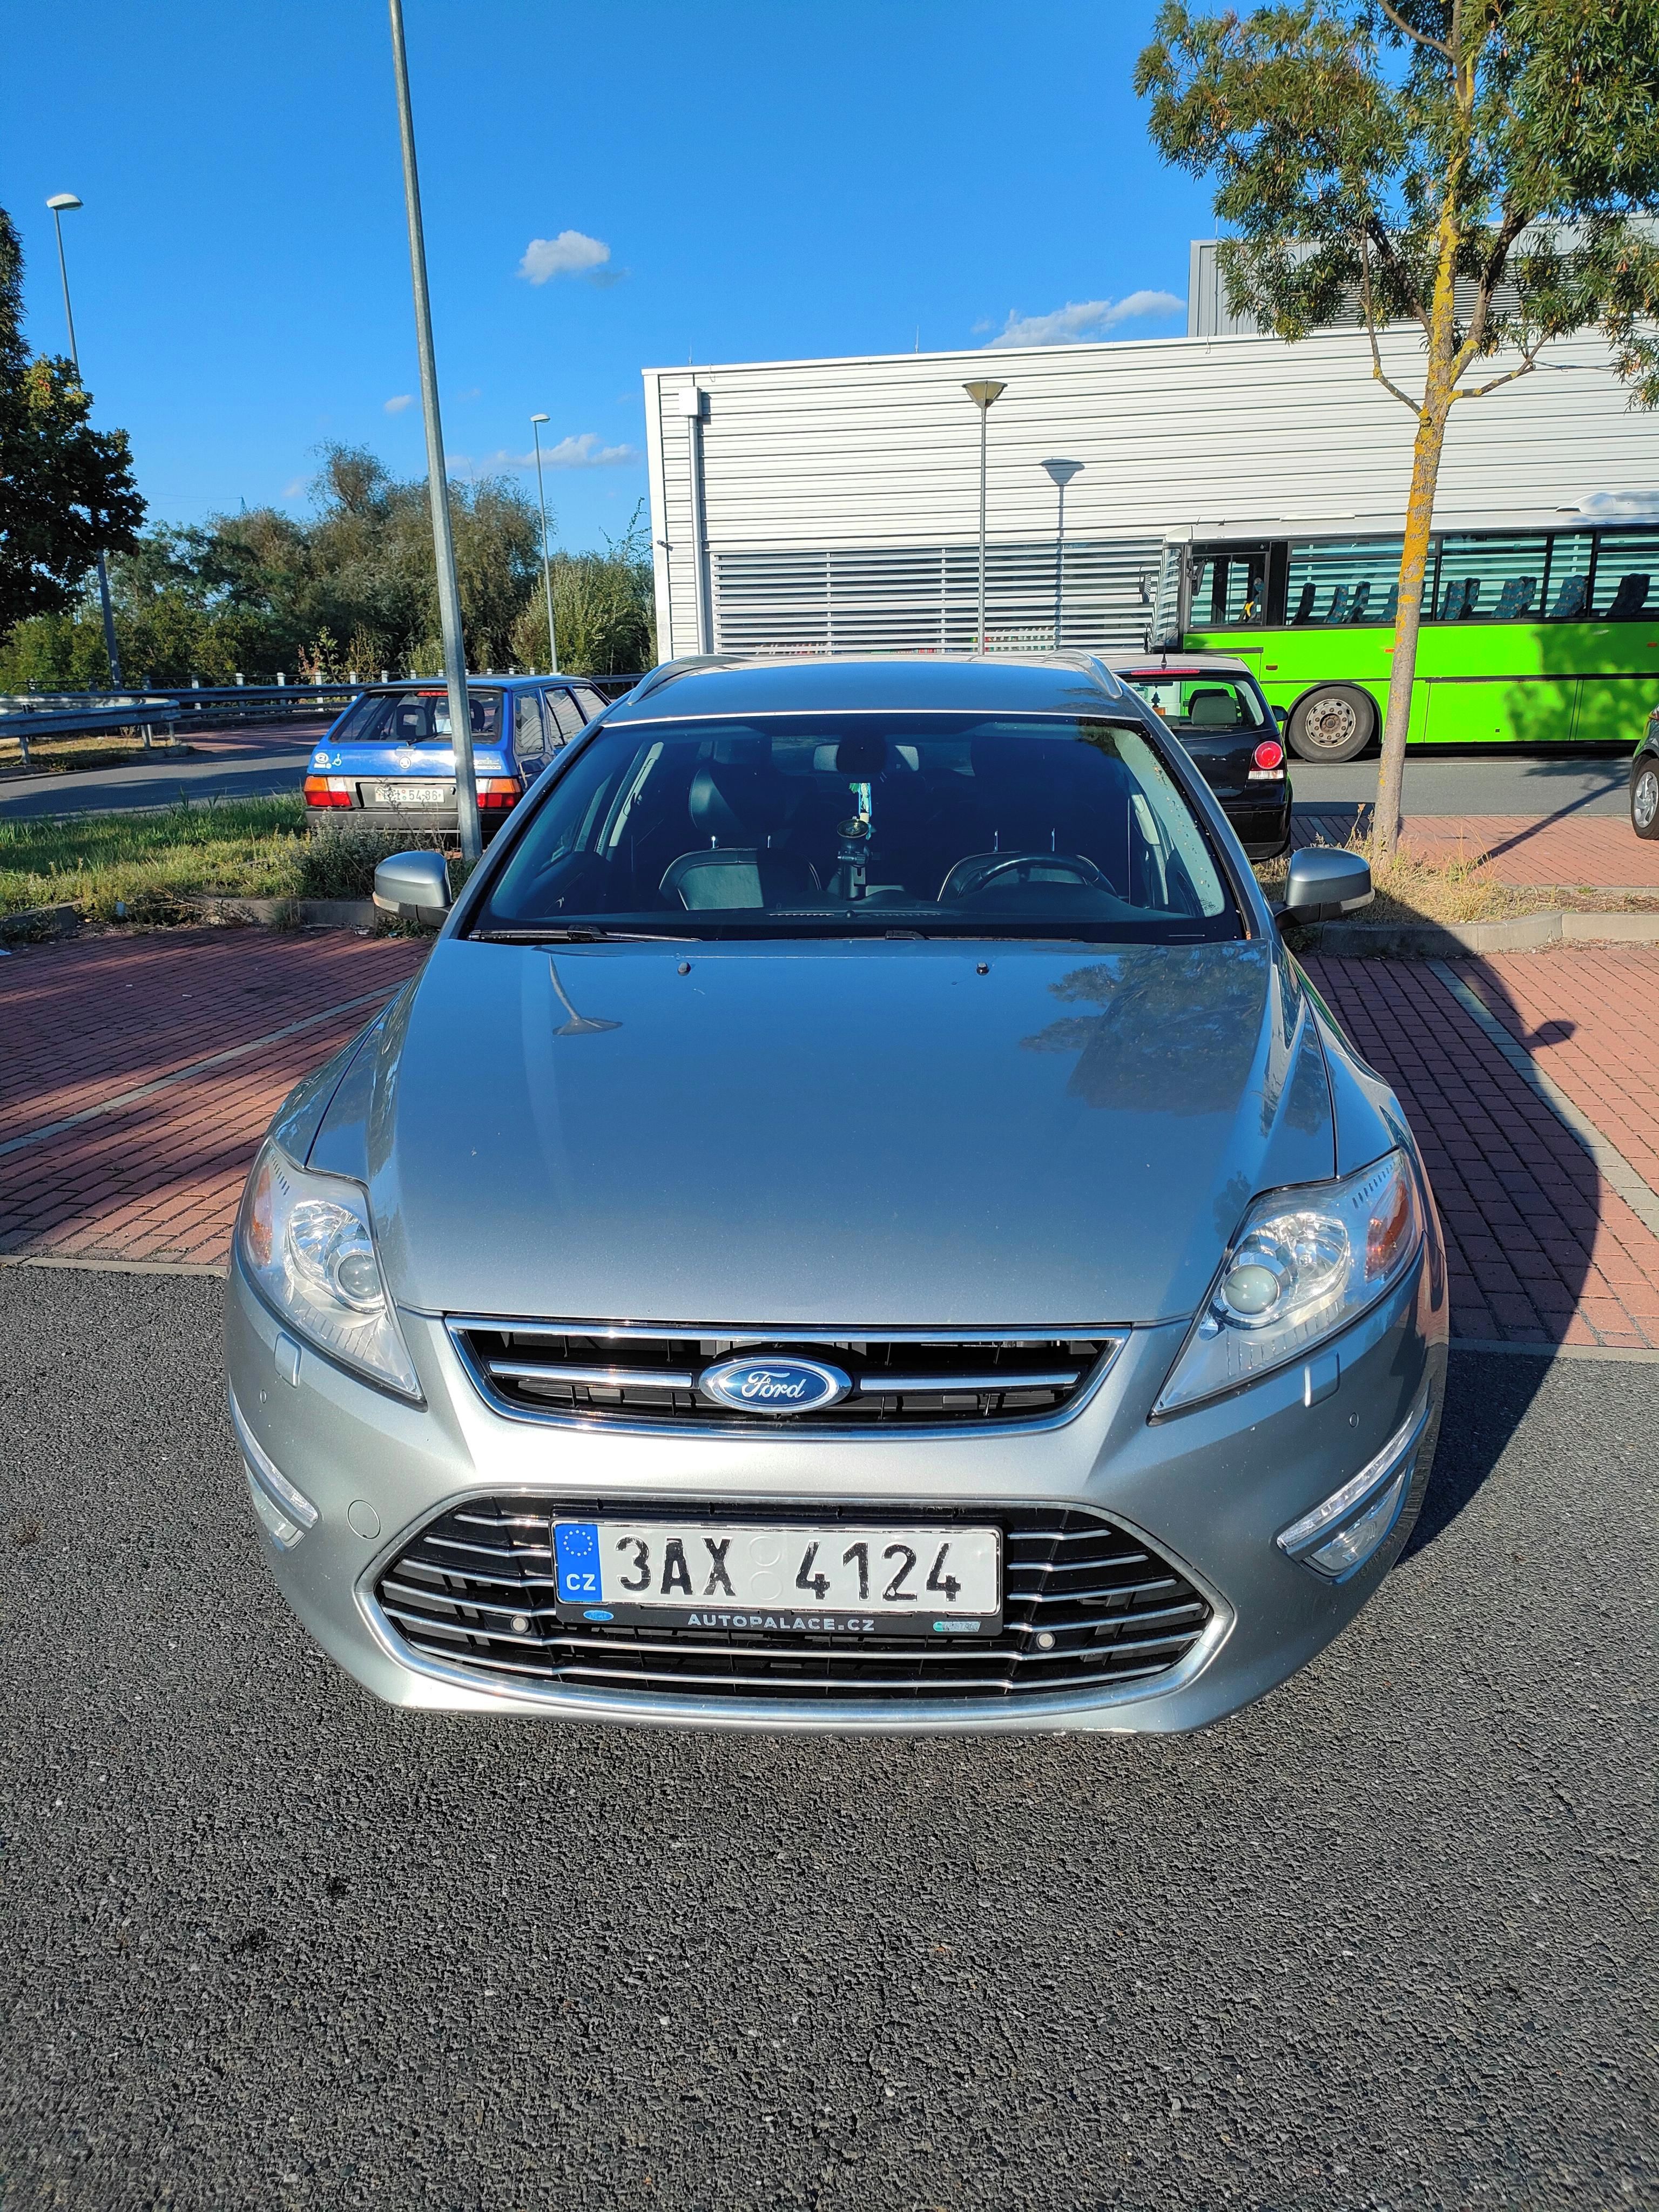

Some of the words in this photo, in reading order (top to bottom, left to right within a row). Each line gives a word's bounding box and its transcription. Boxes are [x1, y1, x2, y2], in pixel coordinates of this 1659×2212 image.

[741, 1371, 807, 1398] Ford
[615, 1536, 736, 1596] 3AX
[795, 1541, 962, 1602] 4124
[566, 1573, 596, 1591] CZ
[687, 1614, 875, 1631] AUTOPALACE.CZ
